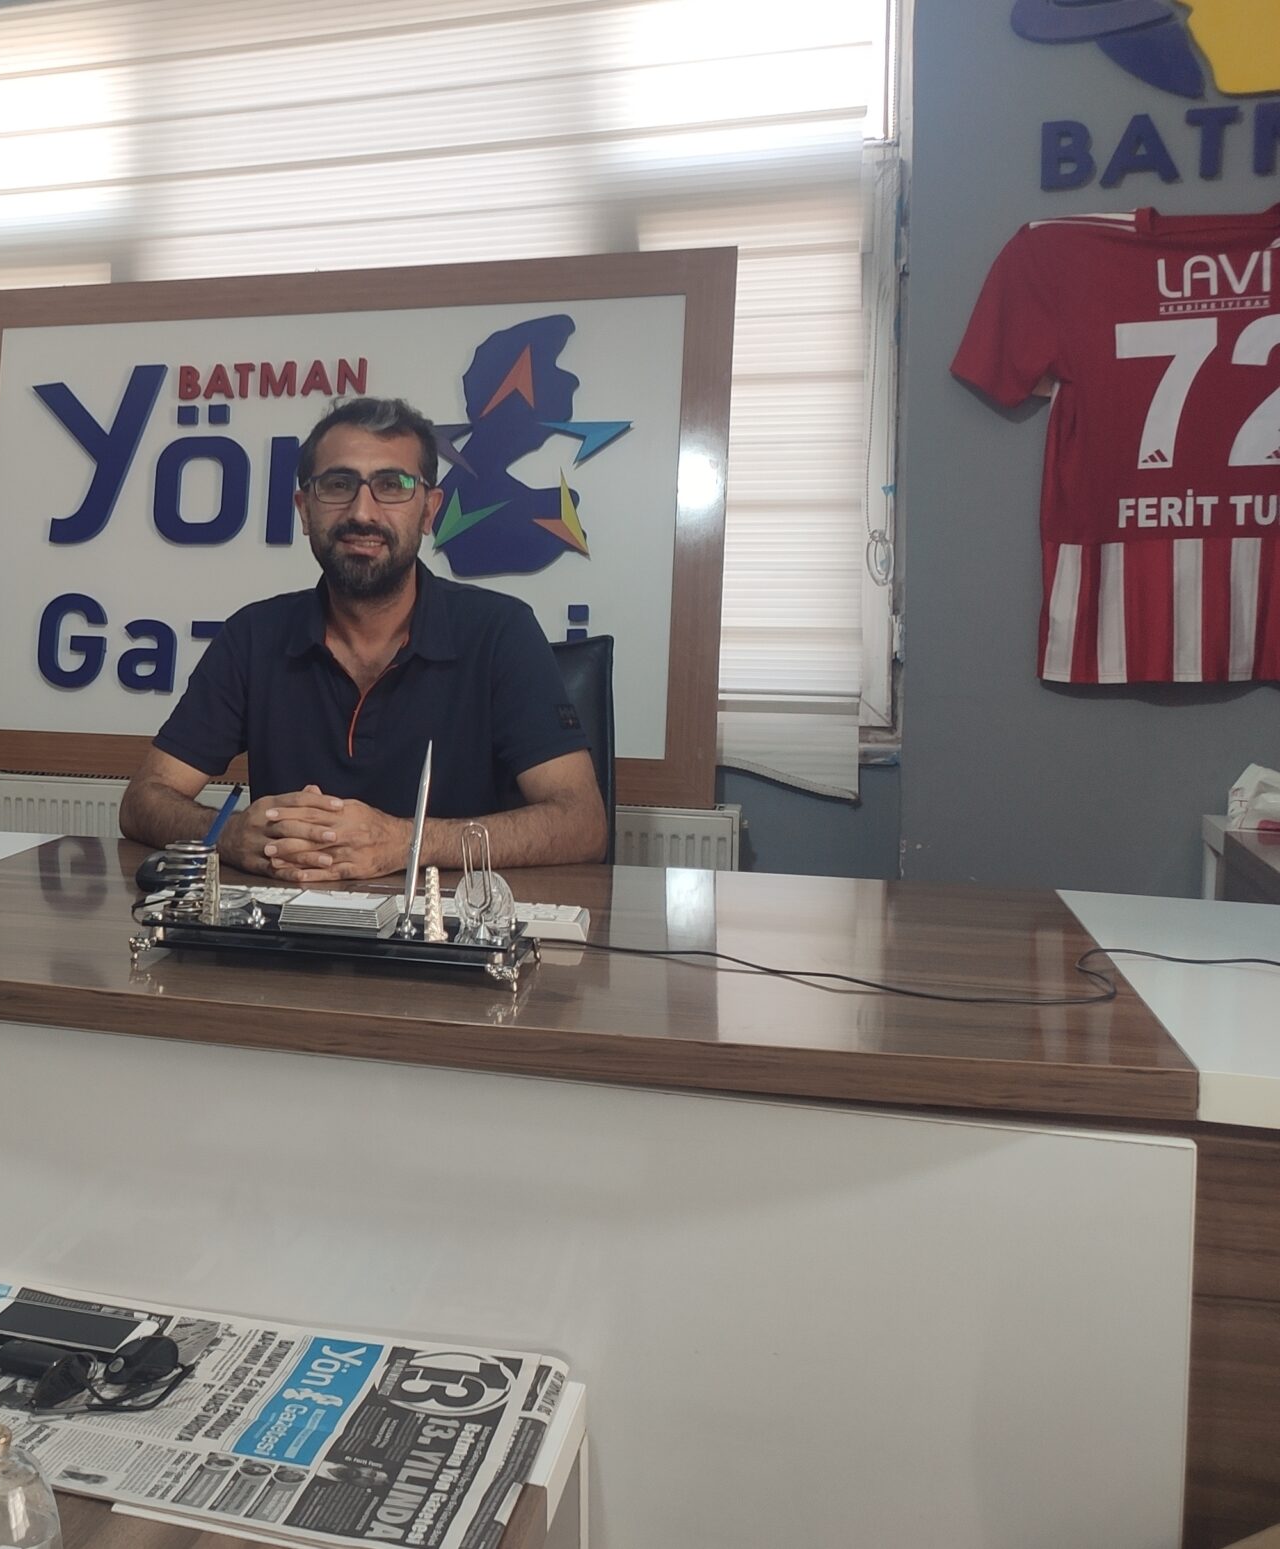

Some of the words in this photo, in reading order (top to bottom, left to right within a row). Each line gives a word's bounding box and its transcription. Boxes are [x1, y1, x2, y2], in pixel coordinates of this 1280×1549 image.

[177, 357, 368, 400] BATMAN
[1118, 488, 1220, 529] FERİT
[300, 1344, 368, 1387] Yön
[253, 1403, 309, 1458] Gazetesi
[416, 1417, 460, 1445] 13.
[446, 1421, 482, 1467] Batman
[364, 1450, 446, 1540] YILINDA
[434, 1467, 462, 1491] Yön
[405, 1491, 449, 1545] Gazetesi
